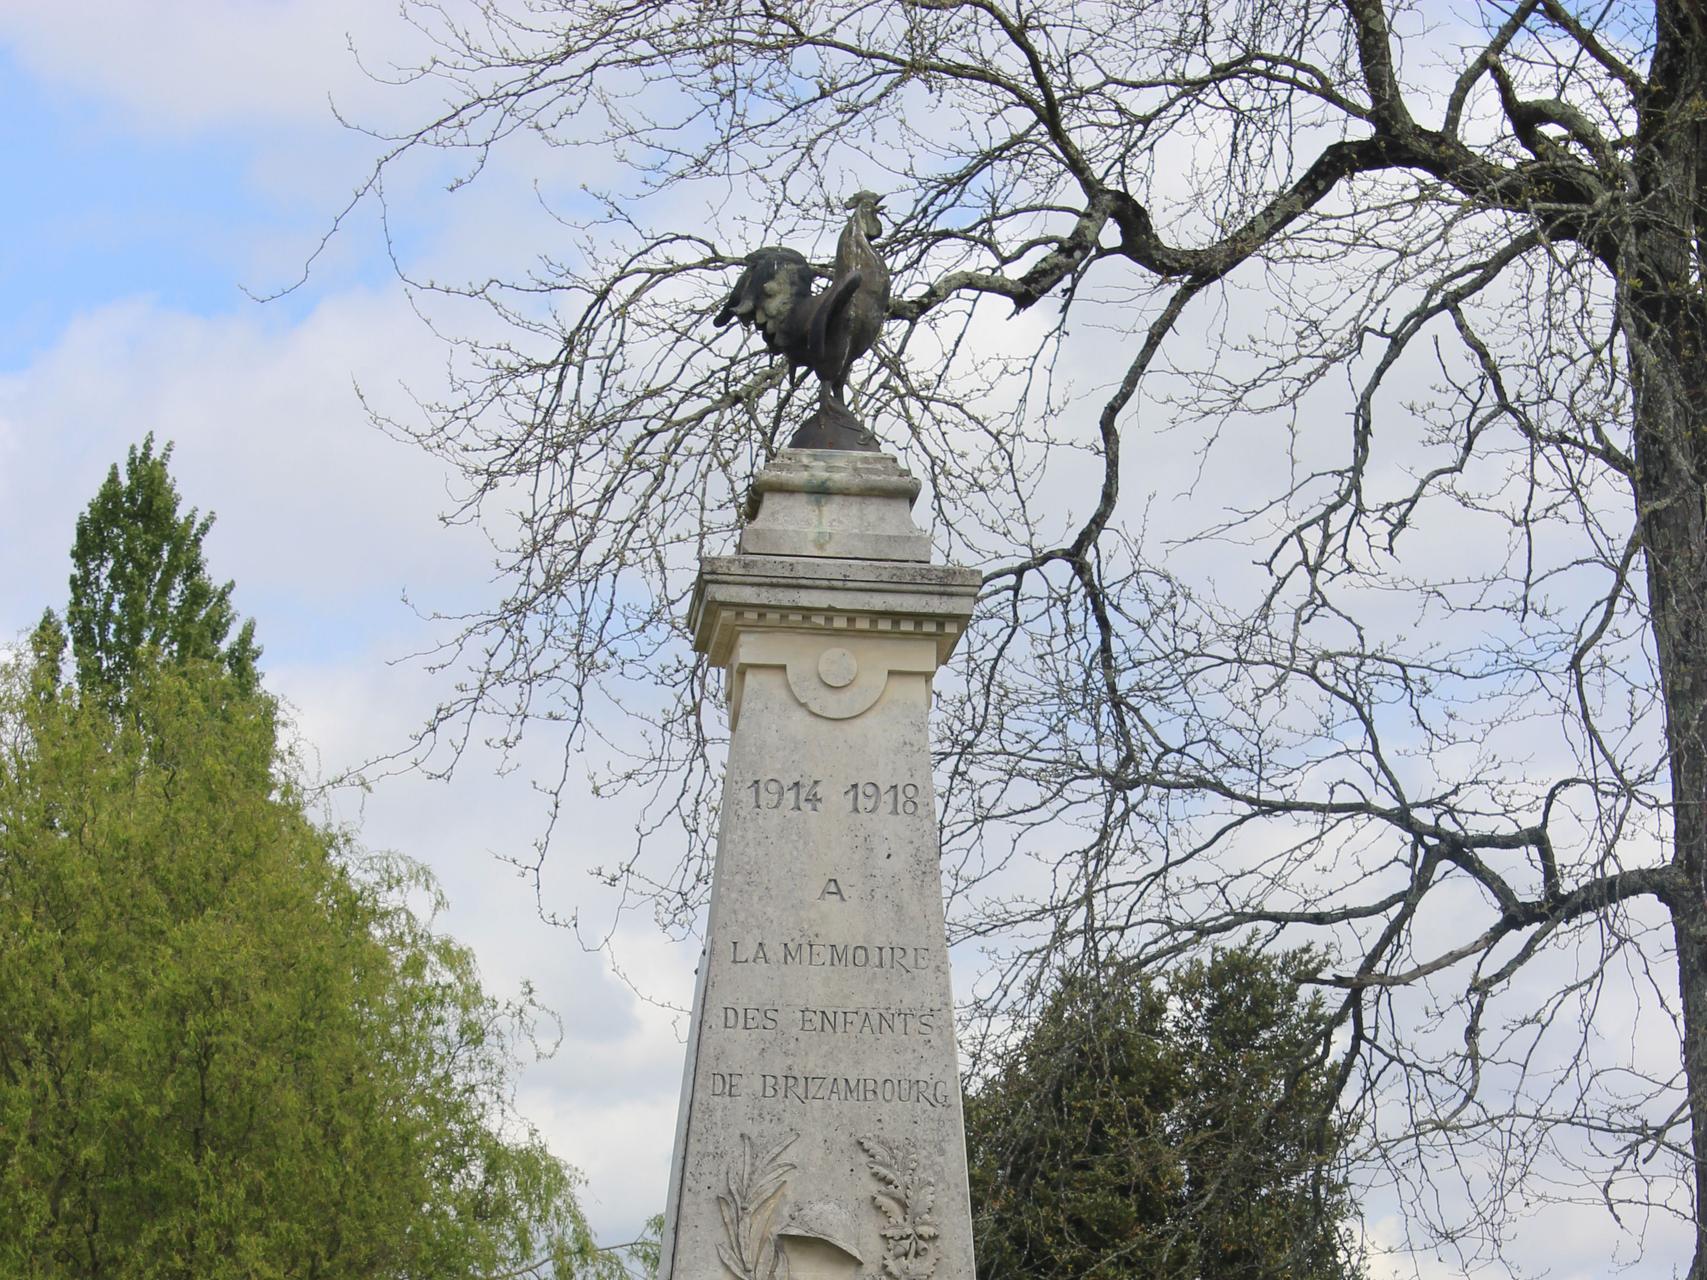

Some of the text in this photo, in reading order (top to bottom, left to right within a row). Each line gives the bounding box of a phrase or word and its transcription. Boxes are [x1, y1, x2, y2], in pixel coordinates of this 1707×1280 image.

[747, 778, 920, 816] 1914 1918
[818, 879, 847, 901] A
[730, 940, 929, 974] LA MEMOIRE
[722, 1007, 935, 1036] DES ENFANTS
[711, 1073, 948, 1107] DE BRIZAMBOURG
